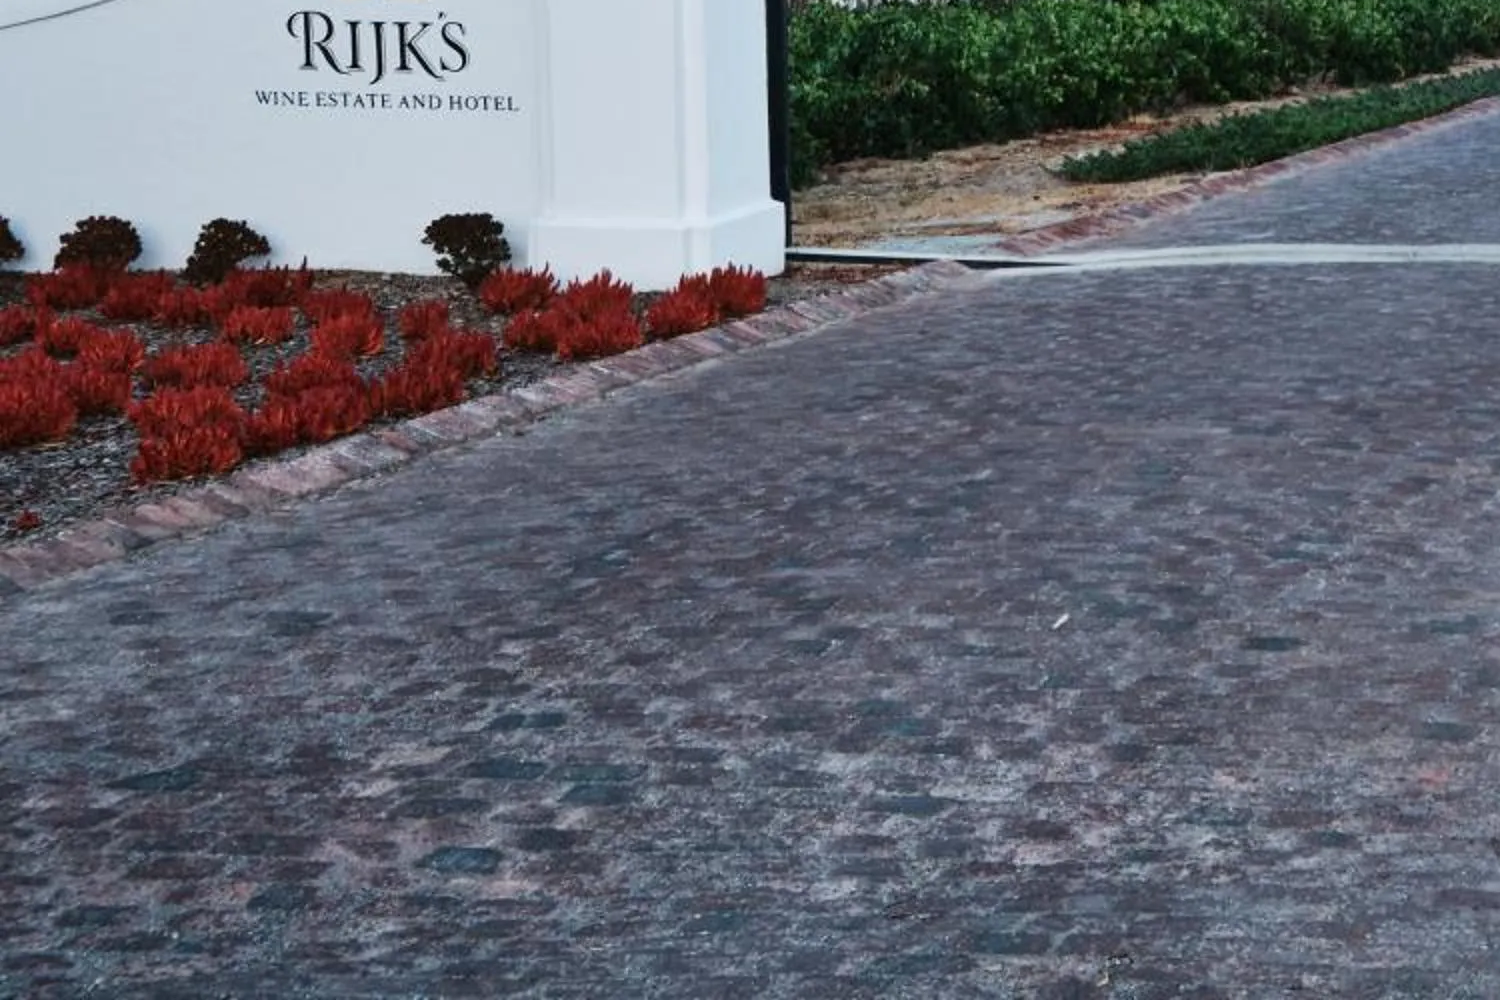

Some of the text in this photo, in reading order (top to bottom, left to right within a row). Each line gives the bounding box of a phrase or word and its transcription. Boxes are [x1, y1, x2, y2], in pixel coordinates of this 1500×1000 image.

[286, 10, 470, 85] RIJK'S
[255, 89, 519, 112] WINE ESTATE AND HOTEL
